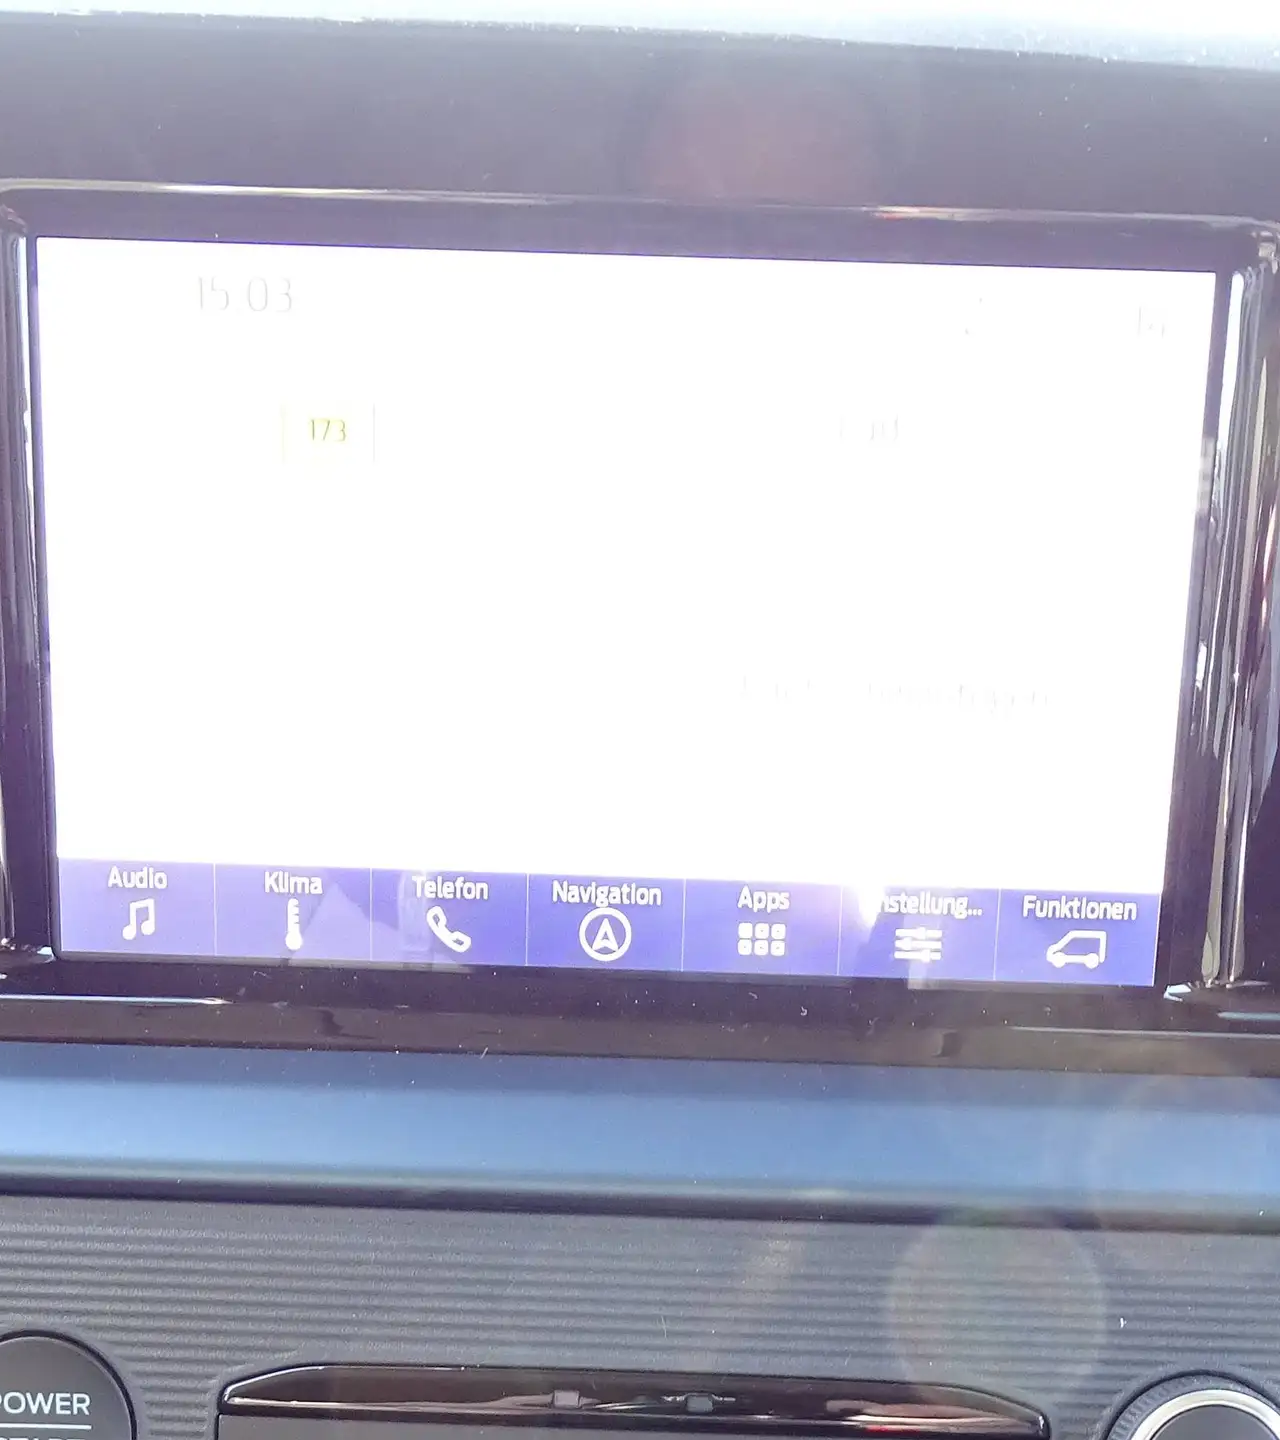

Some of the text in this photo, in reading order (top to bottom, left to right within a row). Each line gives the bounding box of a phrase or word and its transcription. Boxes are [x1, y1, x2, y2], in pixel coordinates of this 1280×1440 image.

[198, 275, 293, 313] 1503
[310, 418, 347, 443] 173
[107, 866, 168, 889] Audio
[264, 872, 323, 894] Klima
[412, 876, 488, 900] Telefon
[552, 880, 662, 906] Navigation
[737, 886, 789, 911] Apps
[1023, 896, 1138, 921] Funktionen
